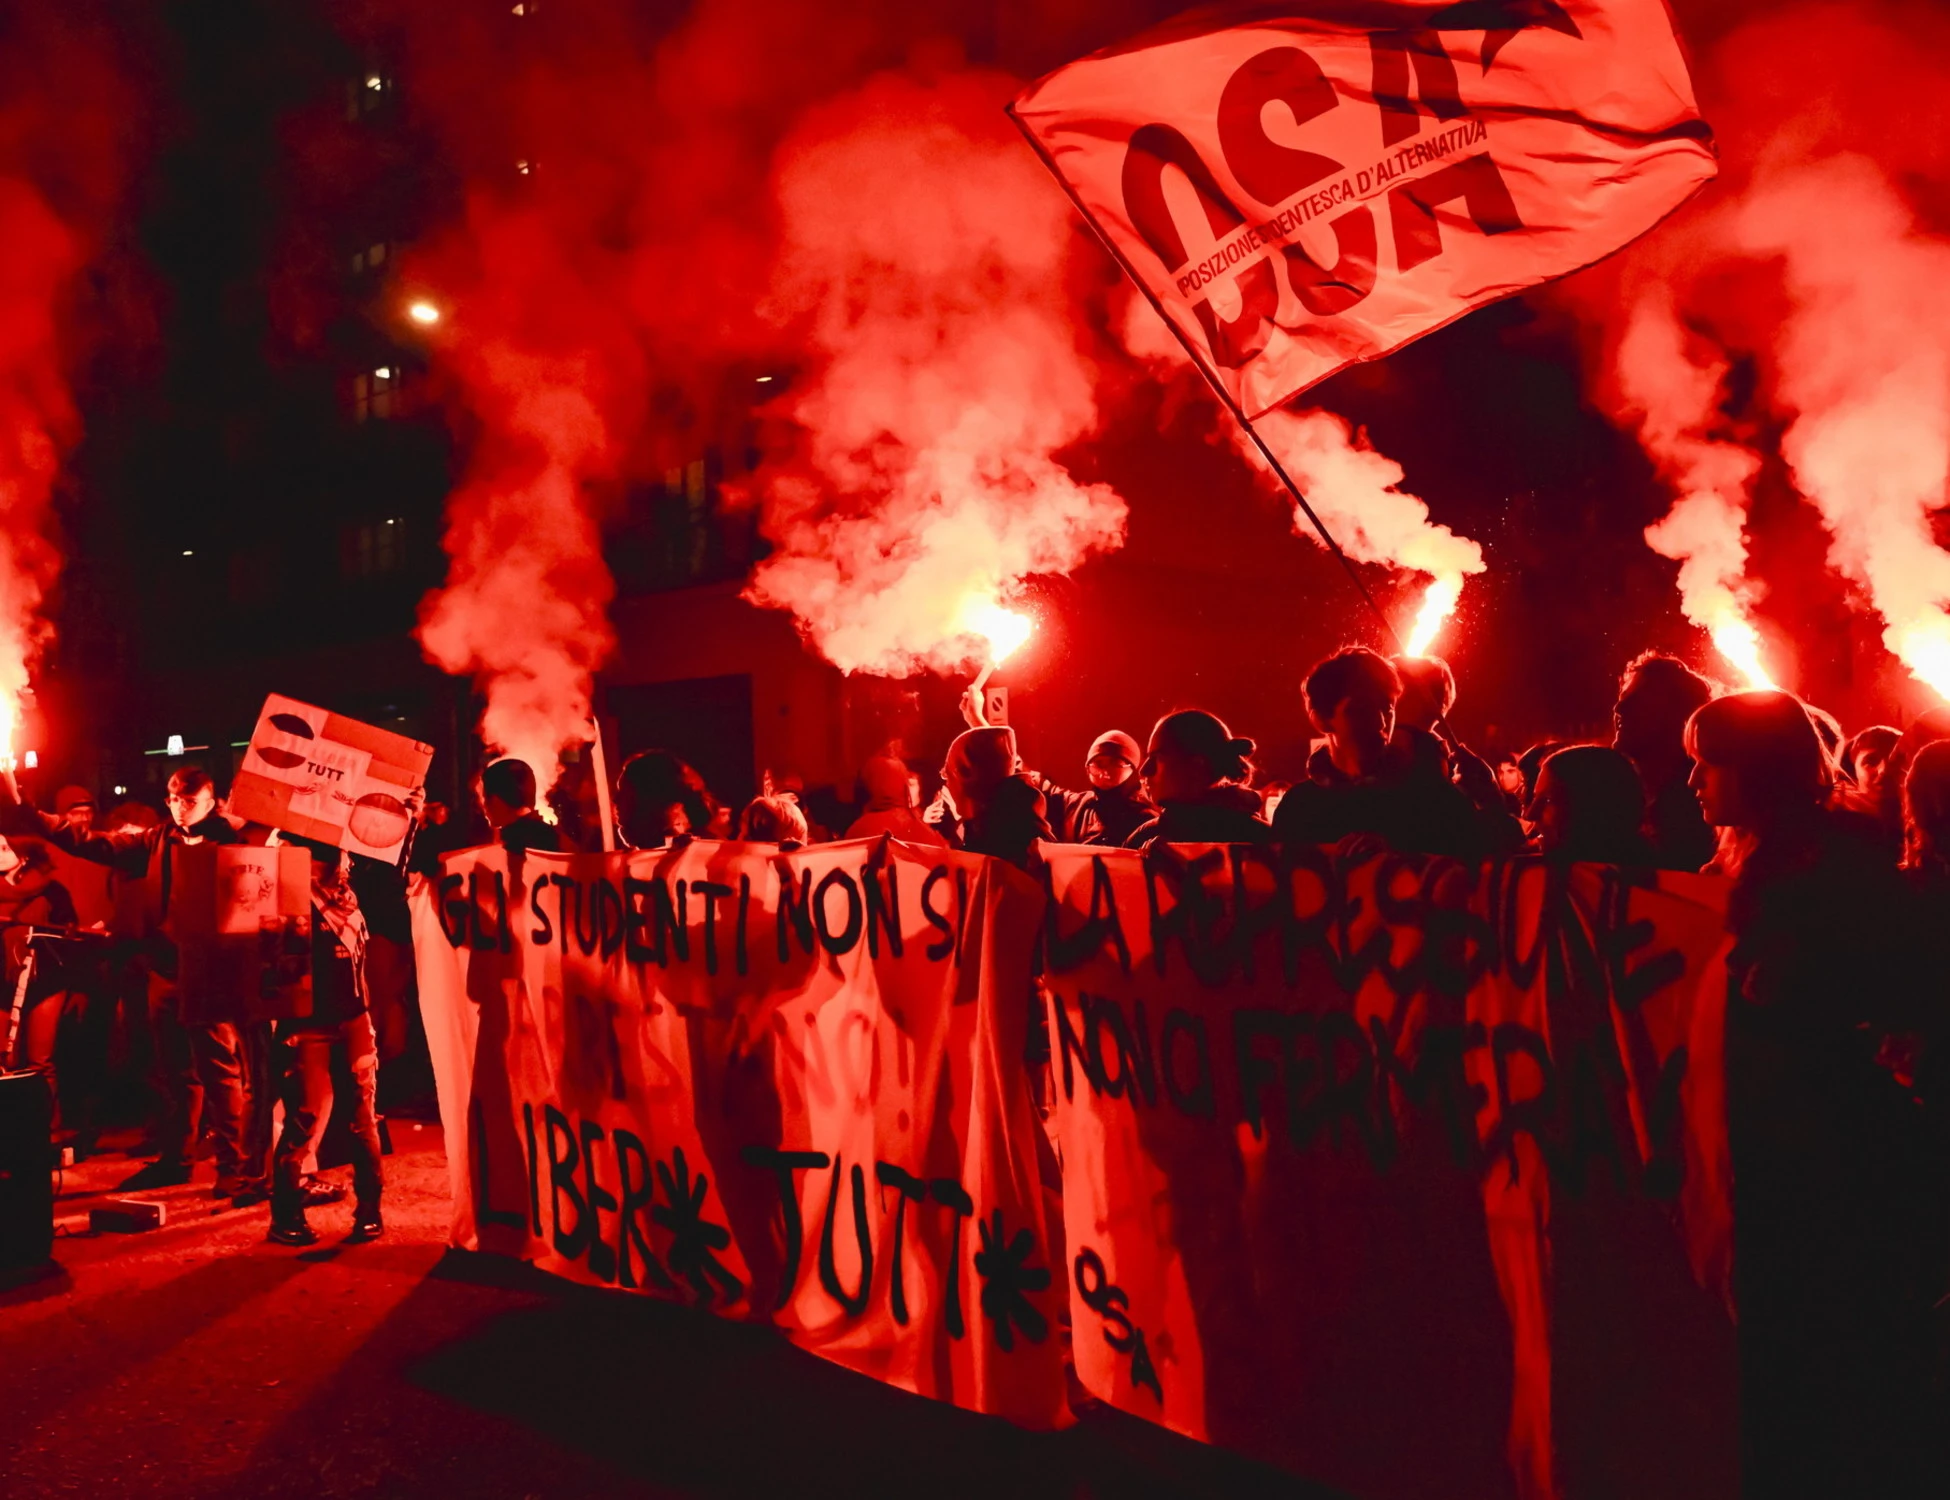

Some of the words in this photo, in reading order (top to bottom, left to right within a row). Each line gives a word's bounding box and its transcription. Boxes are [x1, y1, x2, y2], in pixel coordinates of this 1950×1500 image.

[1355, 120, 1488, 195] D'ALTERNATIVA
[307, 761, 345, 781] TUTT
[438, 870, 512, 955] GLI
[530, 872, 752, 976] STUDENTI
[776, 864, 903, 963] NON
[920, 864, 967, 968] SI
[1043, 853, 1131, 975] LA
[1143, 846, 1688, 1007] REPRESSIONE
[1054, 990, 1159, 1109] NON
[1073, 1245, 1163, 1407] OSA
